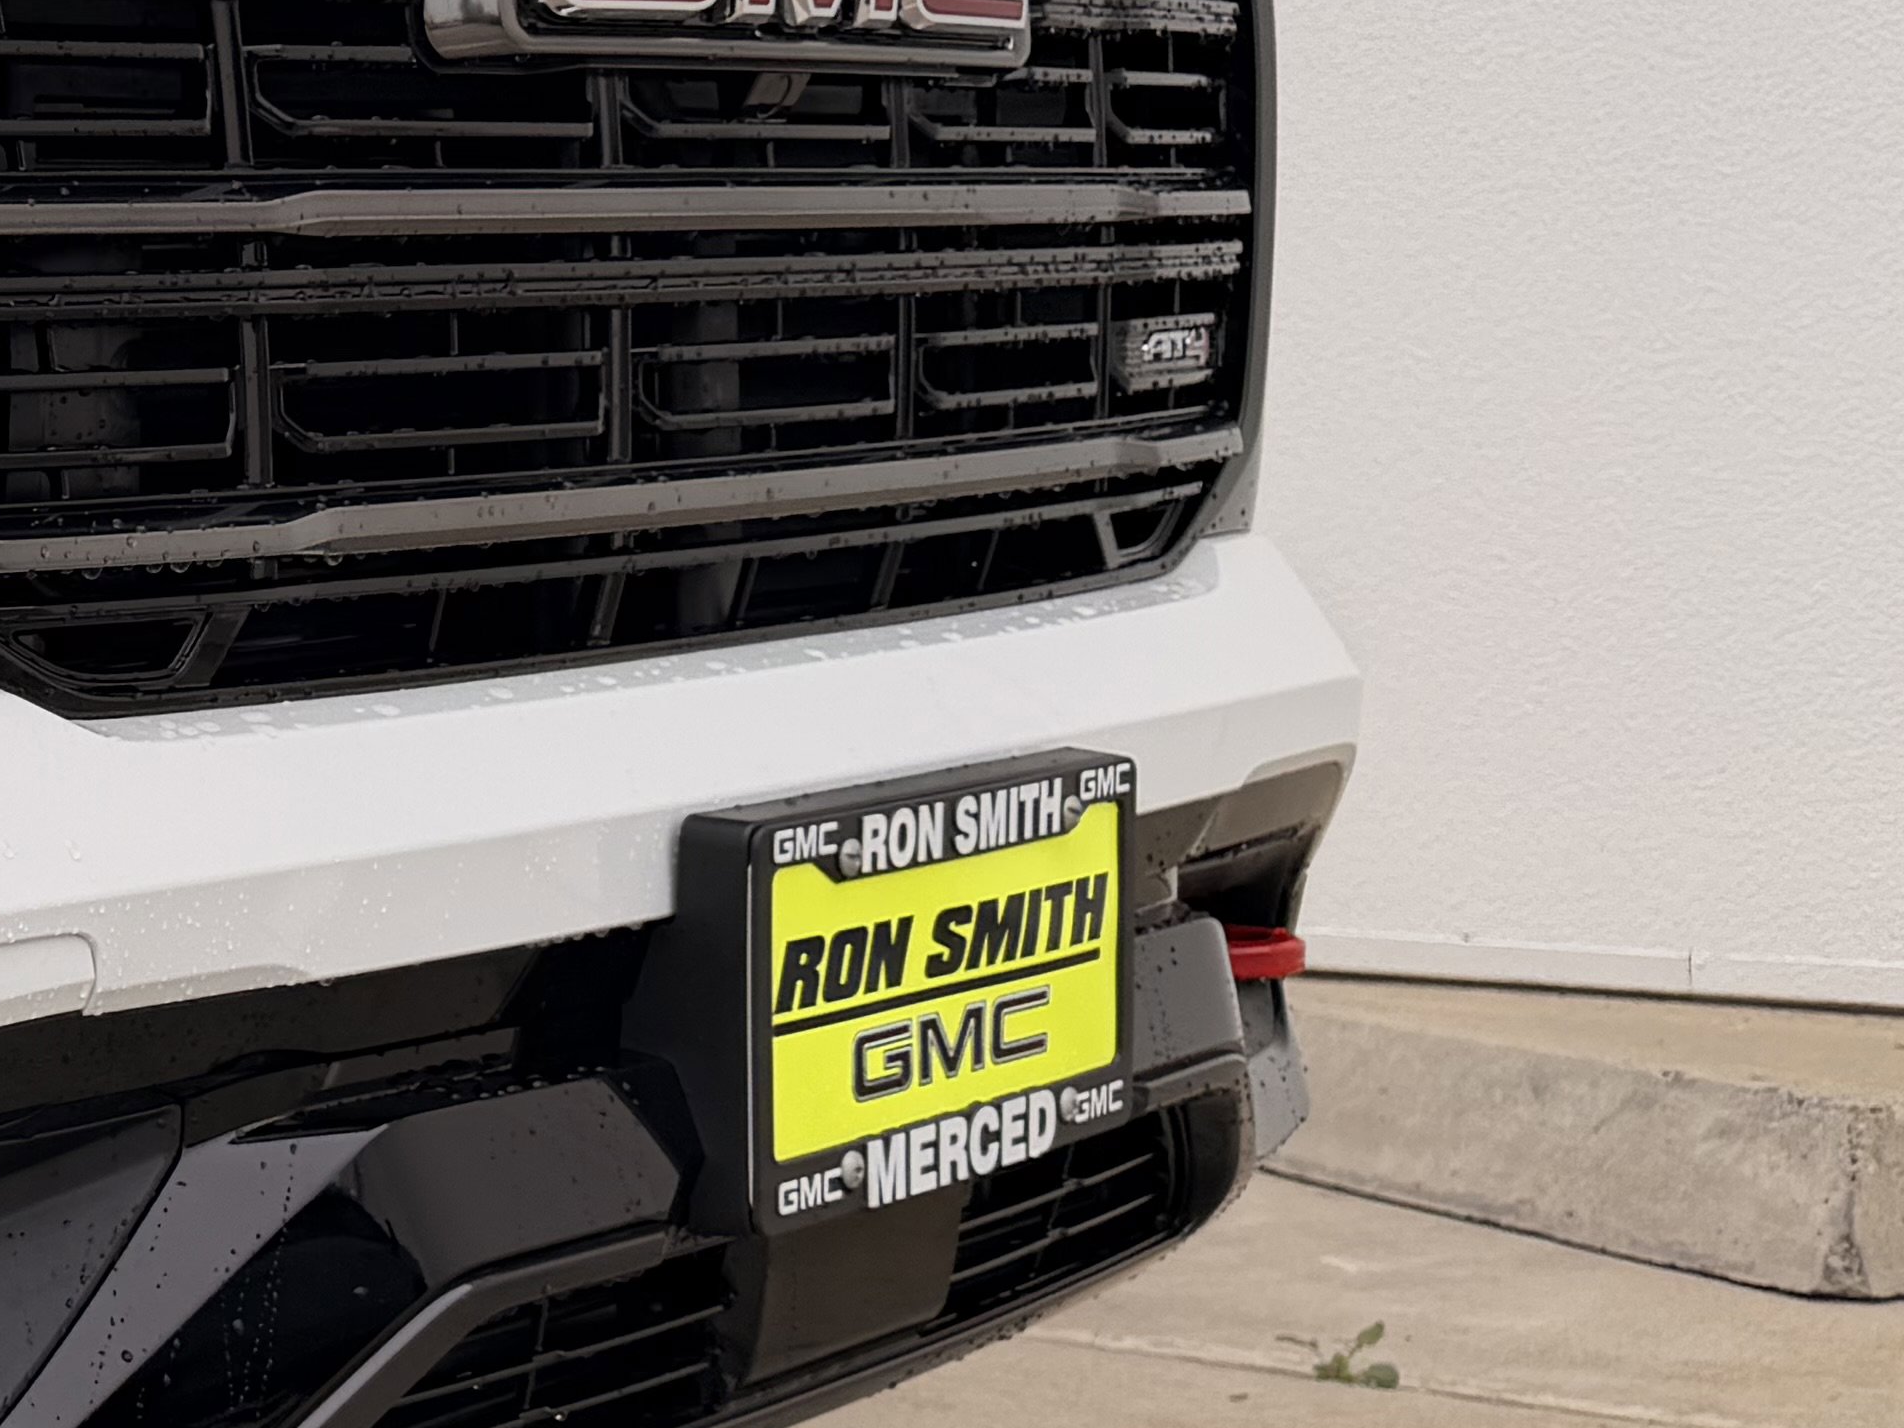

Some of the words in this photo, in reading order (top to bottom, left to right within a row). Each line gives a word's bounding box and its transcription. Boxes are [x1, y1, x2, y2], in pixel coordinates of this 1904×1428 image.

[1141, 326, 1210, 367] AT4
[1079, 762, 1131, 802] GMC
[773, 820, 839, 865] GMC
[861, 801, 945, 873] RON
[955, 777, 1063, 855] SMITH
[775, 914, 914, 1014] RON
[924, 871, 1109, 979] SMITH
[852, 984, 1051, 1104] GMC
[1073, 1078, 1124, 1124] GMC
[866, 1088, 1057, 1209] MERCED
[777, 1166, 843, 1217] GMC
